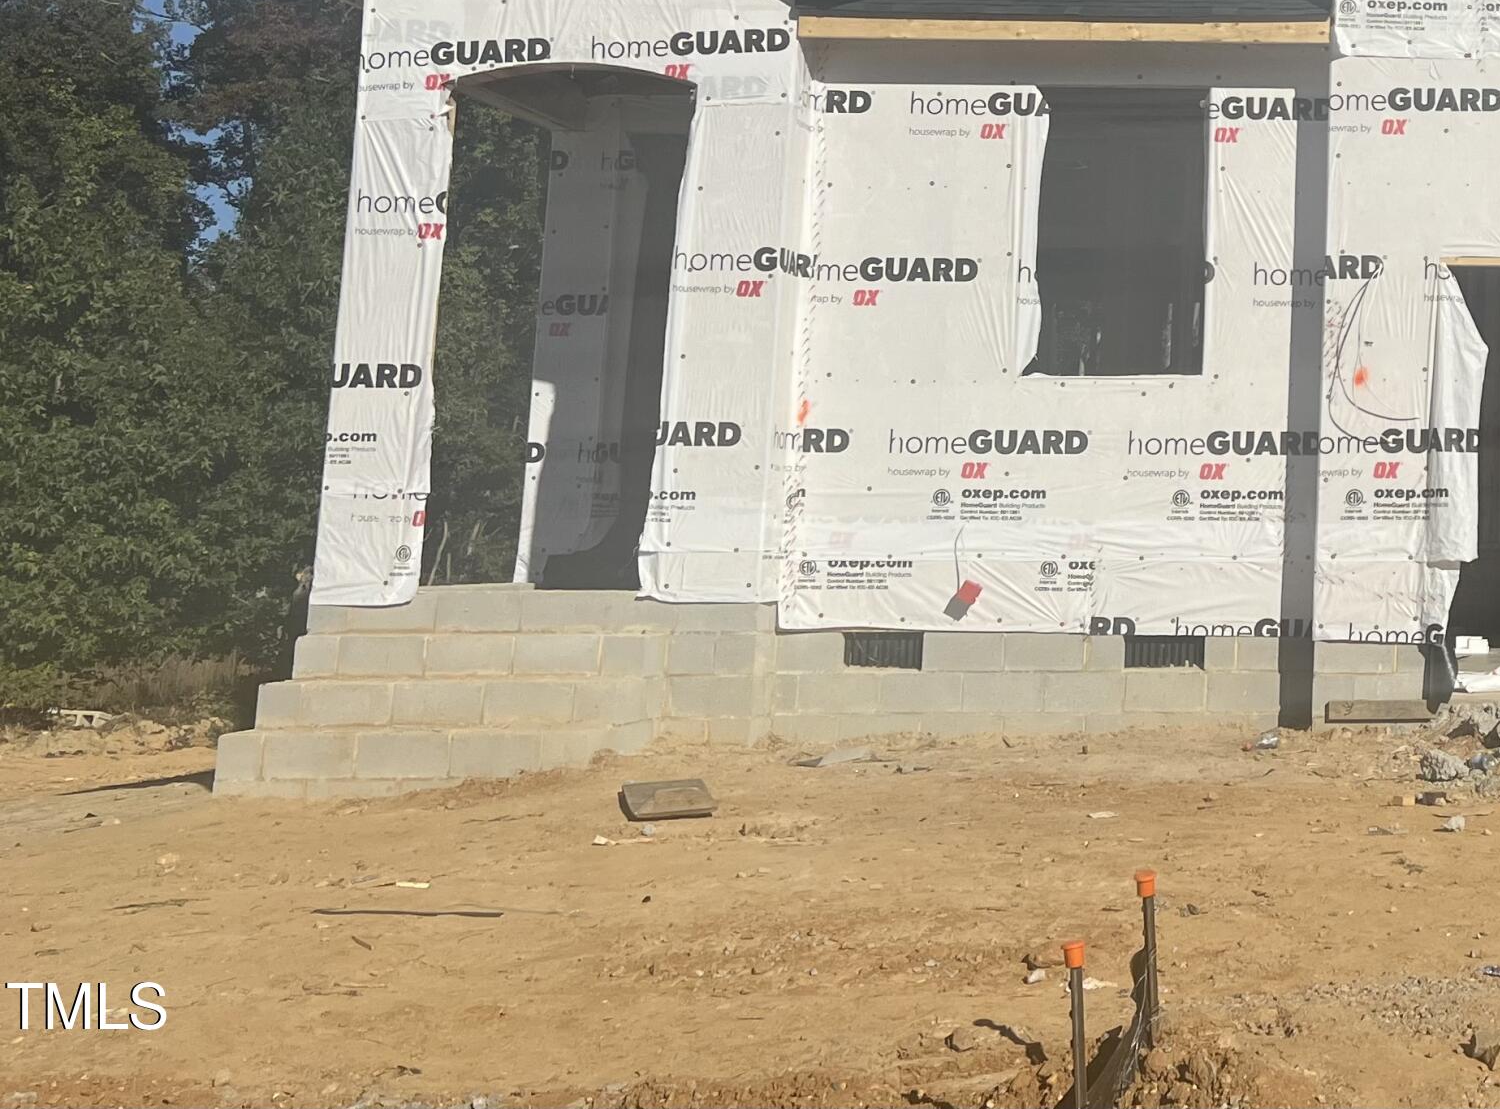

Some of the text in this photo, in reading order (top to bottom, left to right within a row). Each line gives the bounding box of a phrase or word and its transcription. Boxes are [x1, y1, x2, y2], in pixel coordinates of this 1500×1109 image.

[1367, 0, 1448, 12] oxep.com
[592, 28, 790, 59] homeGUARD
[980, 124, 1005, 139] OX
[1214, 128, 1239, 143] OX
[1381, 119, 1406, 135] OX
[417, 223, 444, 240] OX
[736, 280, 764, 297] OX
[853, 290, 878, 306] OX
[889, 428, 1088, 455] homeGUARD
[1129, 431, 1318, 456] homeGUARD
[961, 462, 988, 479] OX
[1199, 463, 1225, 480] OX
[1373, 462, 1399, 479] OX
[961, 488, 1047, 501] oxep.com
[1200, 488, 1283, 502] oxep.com
